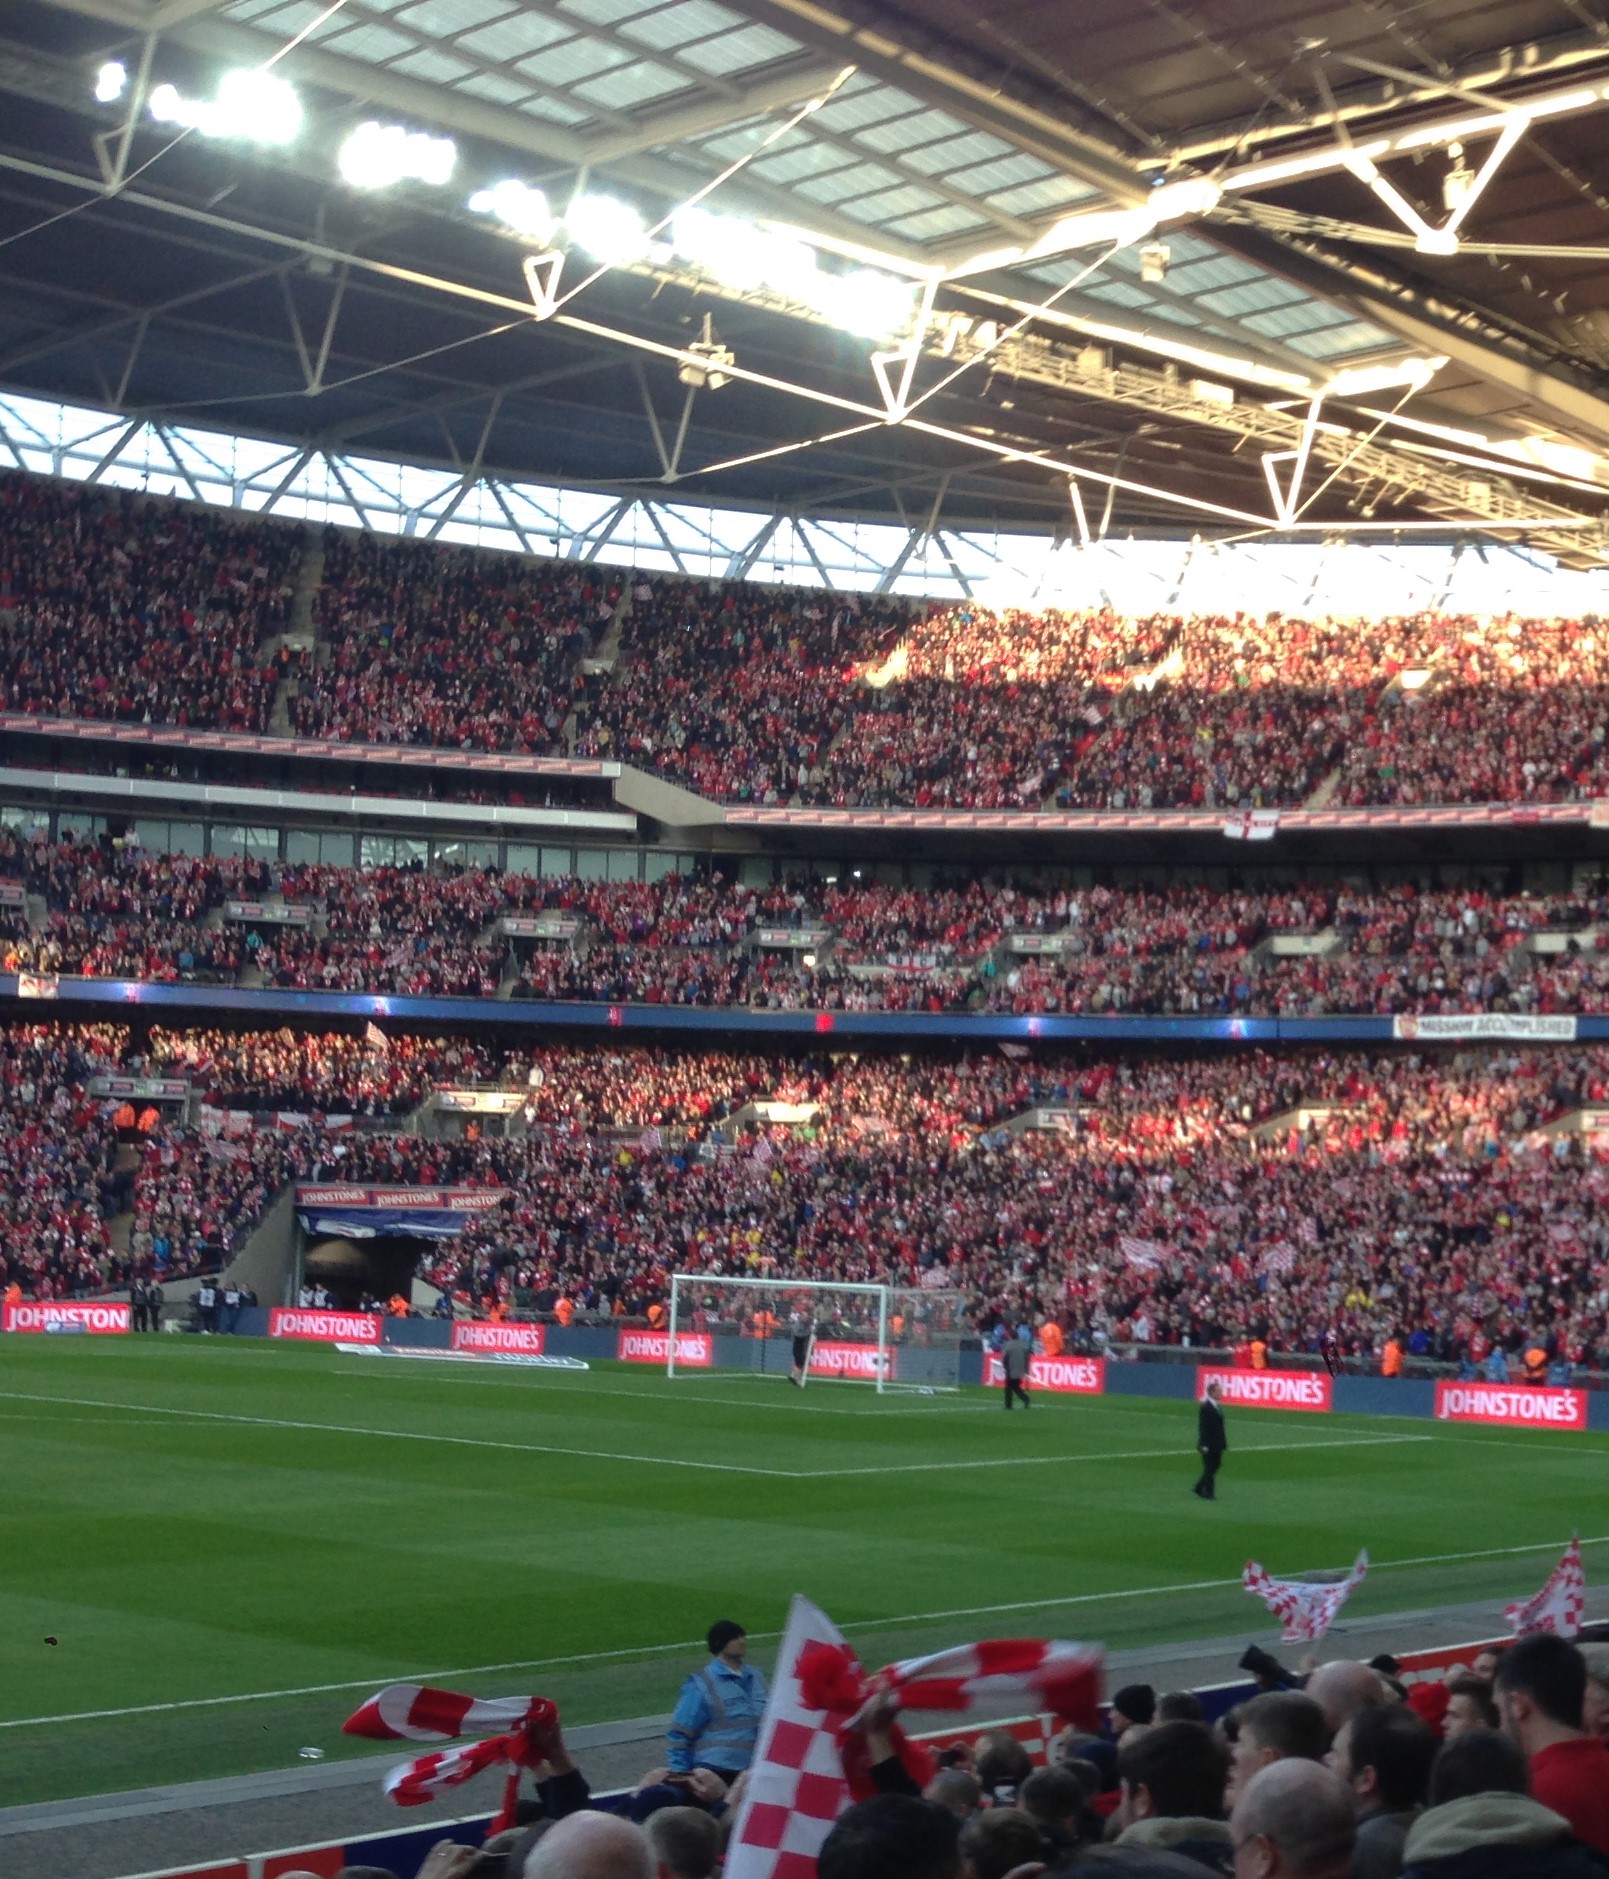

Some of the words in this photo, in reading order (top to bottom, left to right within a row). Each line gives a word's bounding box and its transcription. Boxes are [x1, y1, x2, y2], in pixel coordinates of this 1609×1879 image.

[451, 1194, 501, 1210] JOHNSTON
[272, 1313, 376, 1340] JOHNSTONE'S
[453, 1323, 540, 1350] JOHNSTONE'S
[1439, 1388, 1579, 1422] JOHNSTONE'S
